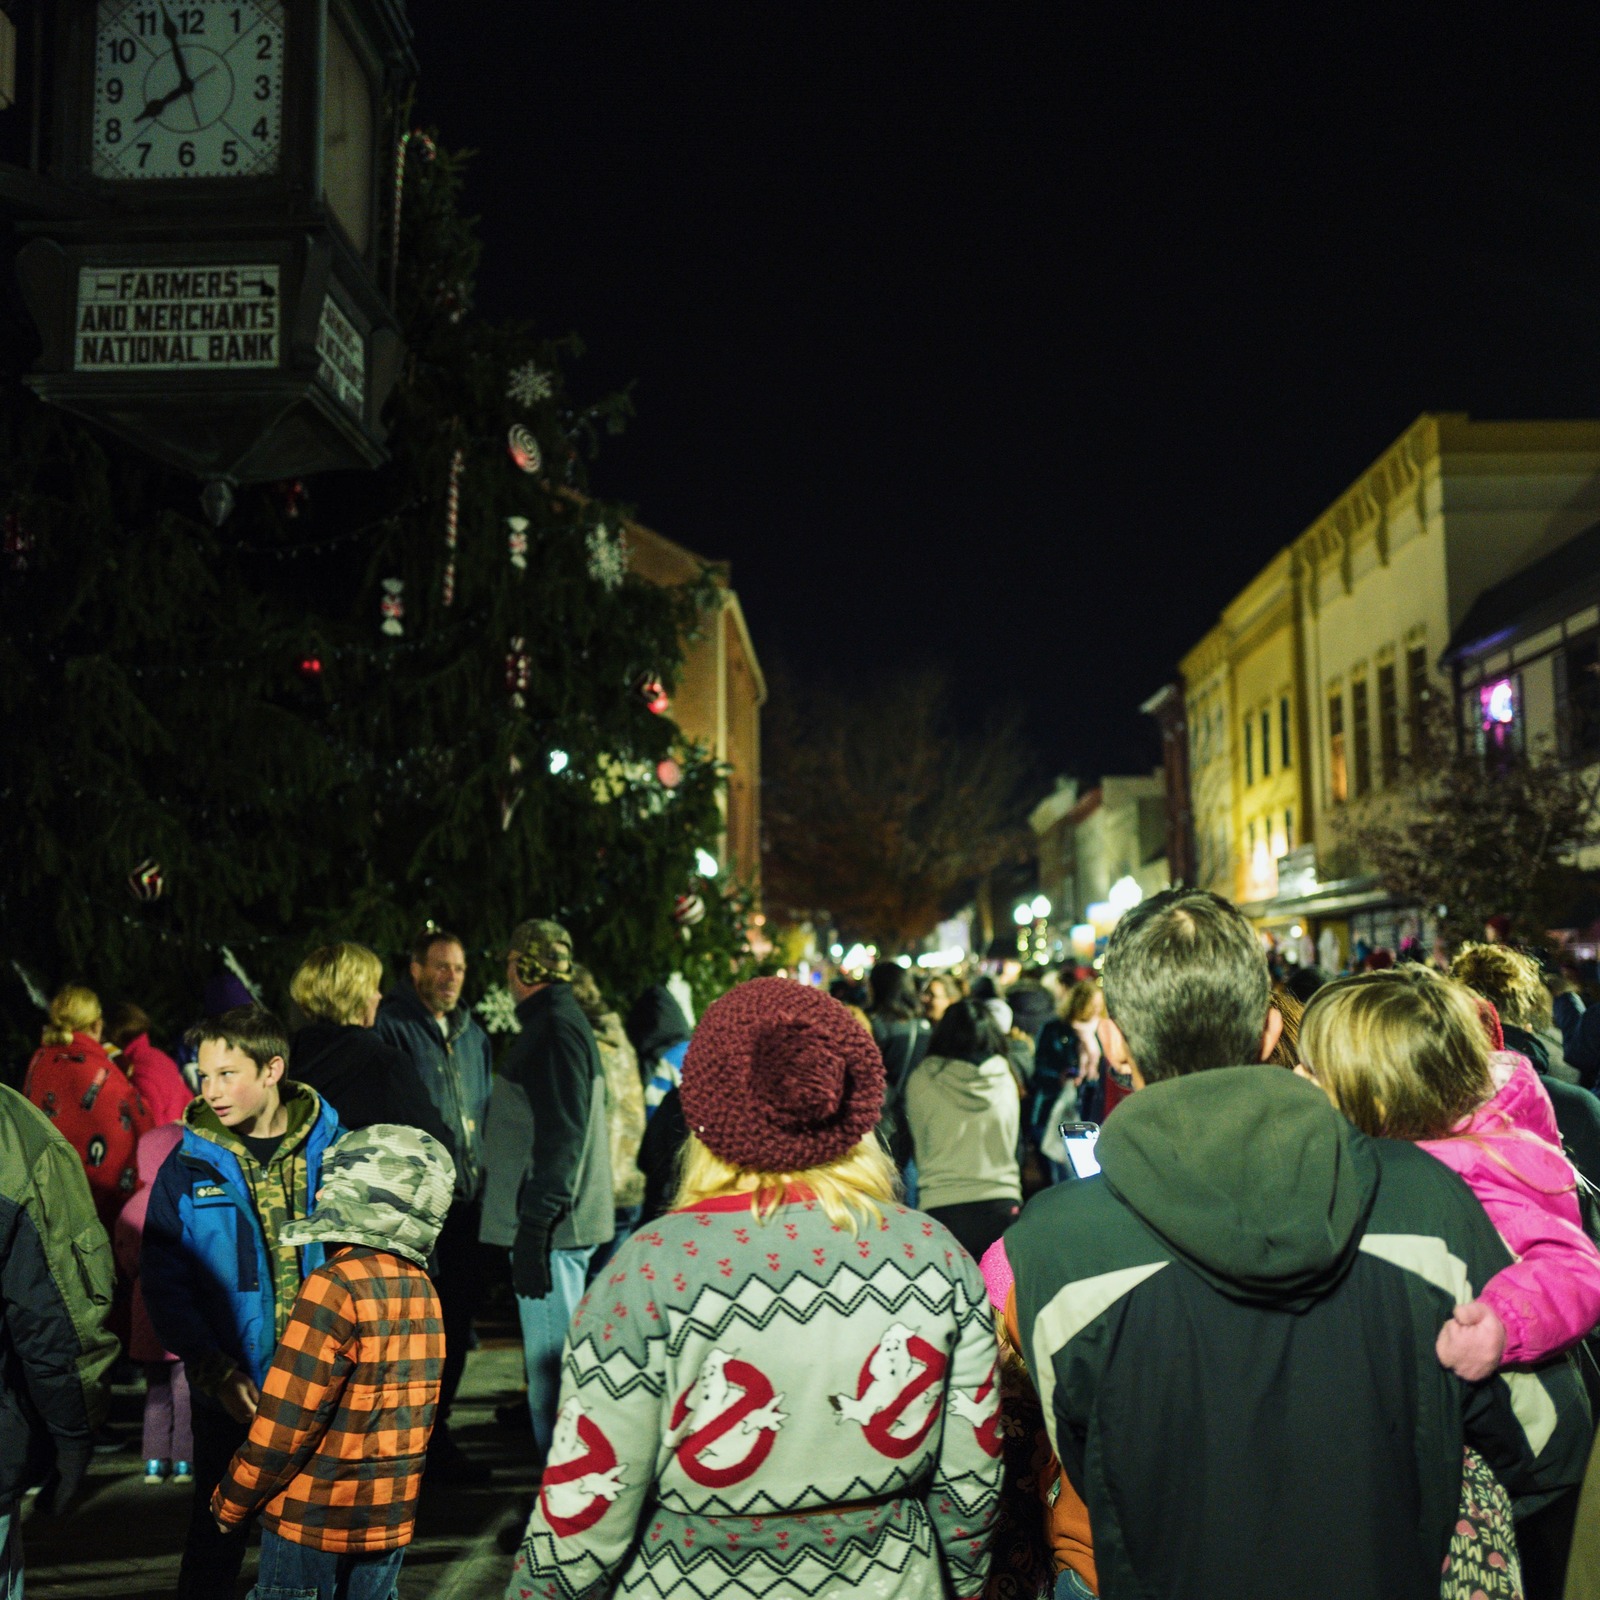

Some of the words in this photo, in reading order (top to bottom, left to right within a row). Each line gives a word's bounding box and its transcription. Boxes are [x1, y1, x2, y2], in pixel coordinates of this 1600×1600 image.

[135, 11, 157, 36] 11
[178, 9, 205, 35] 12
[230, 8, 241, 34] 1
[107, 37, 136, 64] 10
[256, 34, 272, 60] 2
[106, 77, 123, 103] 9
[254, 74, 271, 101] 3
[105, 118, 121, 144] 8
[252, 116, 269, 142] 4
[137, 143, 152, 168] 7
[178, 141, 195, 167] 6
[221, 140, 238, 166] 5
[80, 304, 127, 332] AND
[135, 302, 275, 331] MERCHANTS
[81, 335, 205, 364] NATIONAL
[208, 333, 274, 362] BANK
